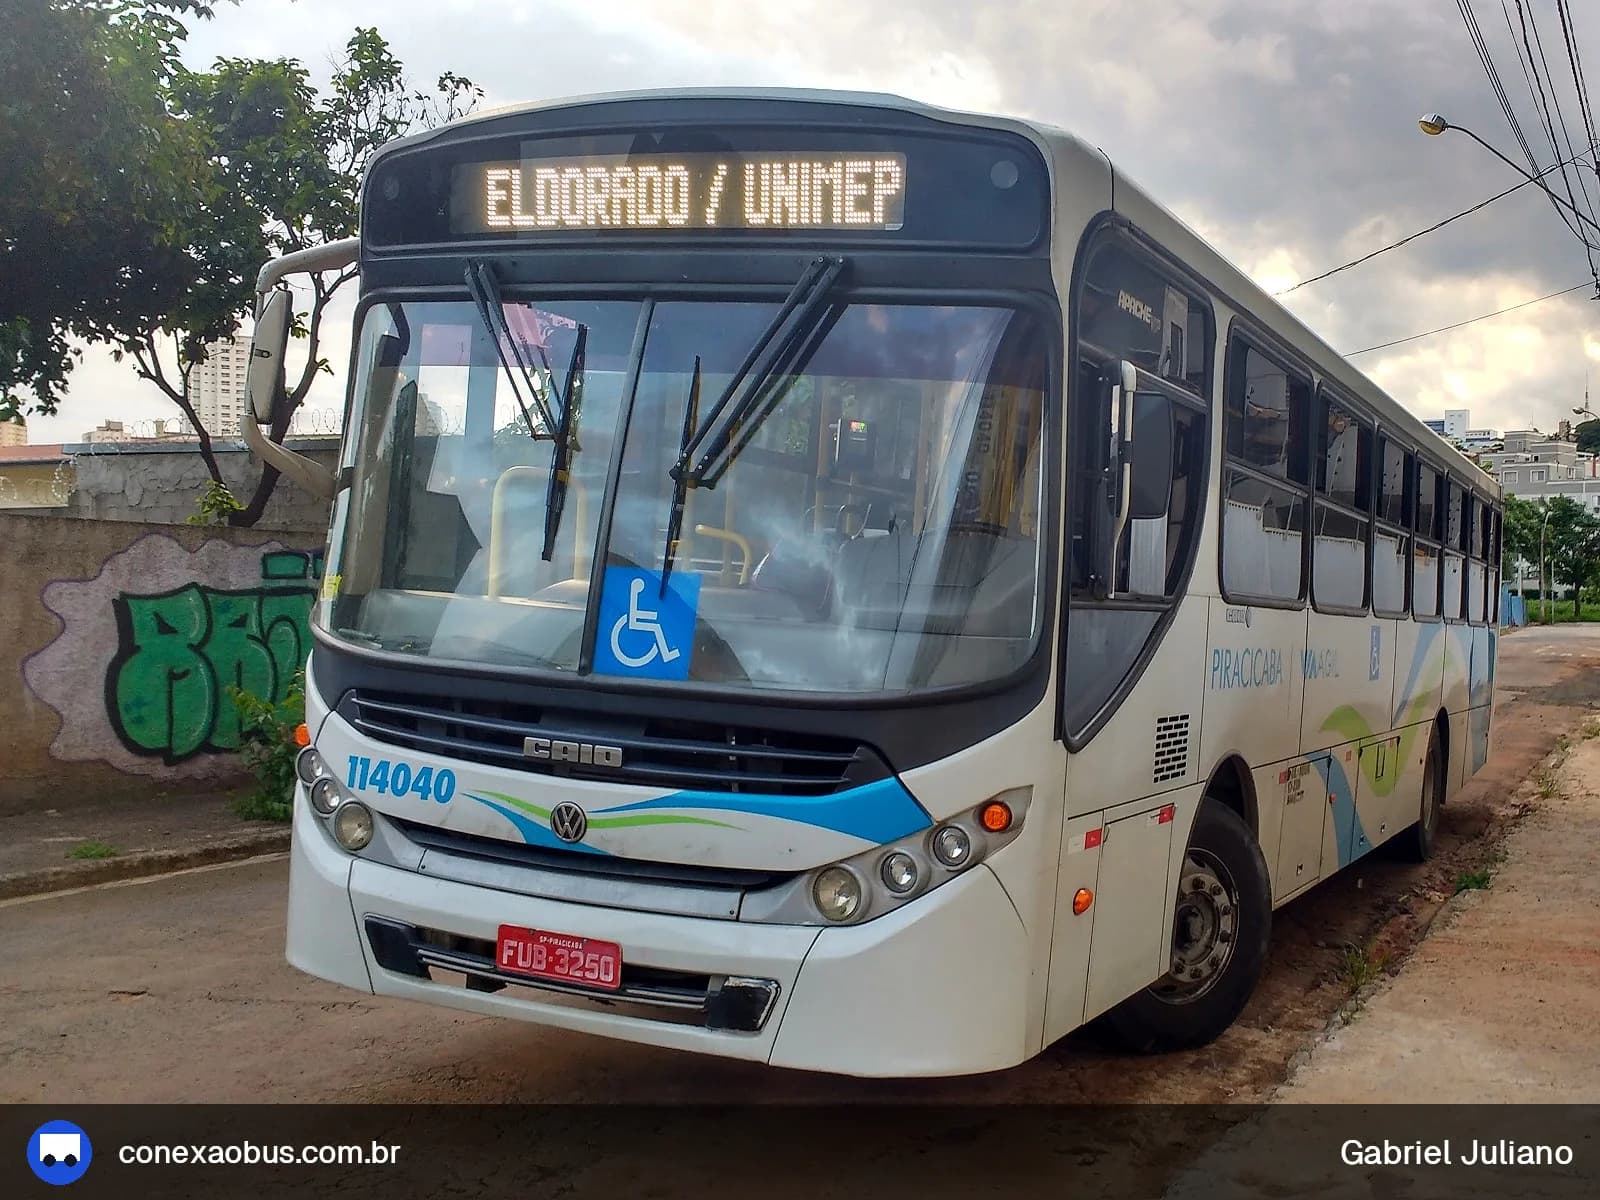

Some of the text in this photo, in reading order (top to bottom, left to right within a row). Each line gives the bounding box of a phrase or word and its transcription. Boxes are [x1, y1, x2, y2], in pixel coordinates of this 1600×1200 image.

[486, 160, 901, 227] ELDORADO / UNIMEP
[1118, 288, 1153, 325] APACHE
[1211, 646, 1283, 690] PIRACICABA
[523, 736, 623, 768] CAIO
[347, 755, 456, 804] 114040
